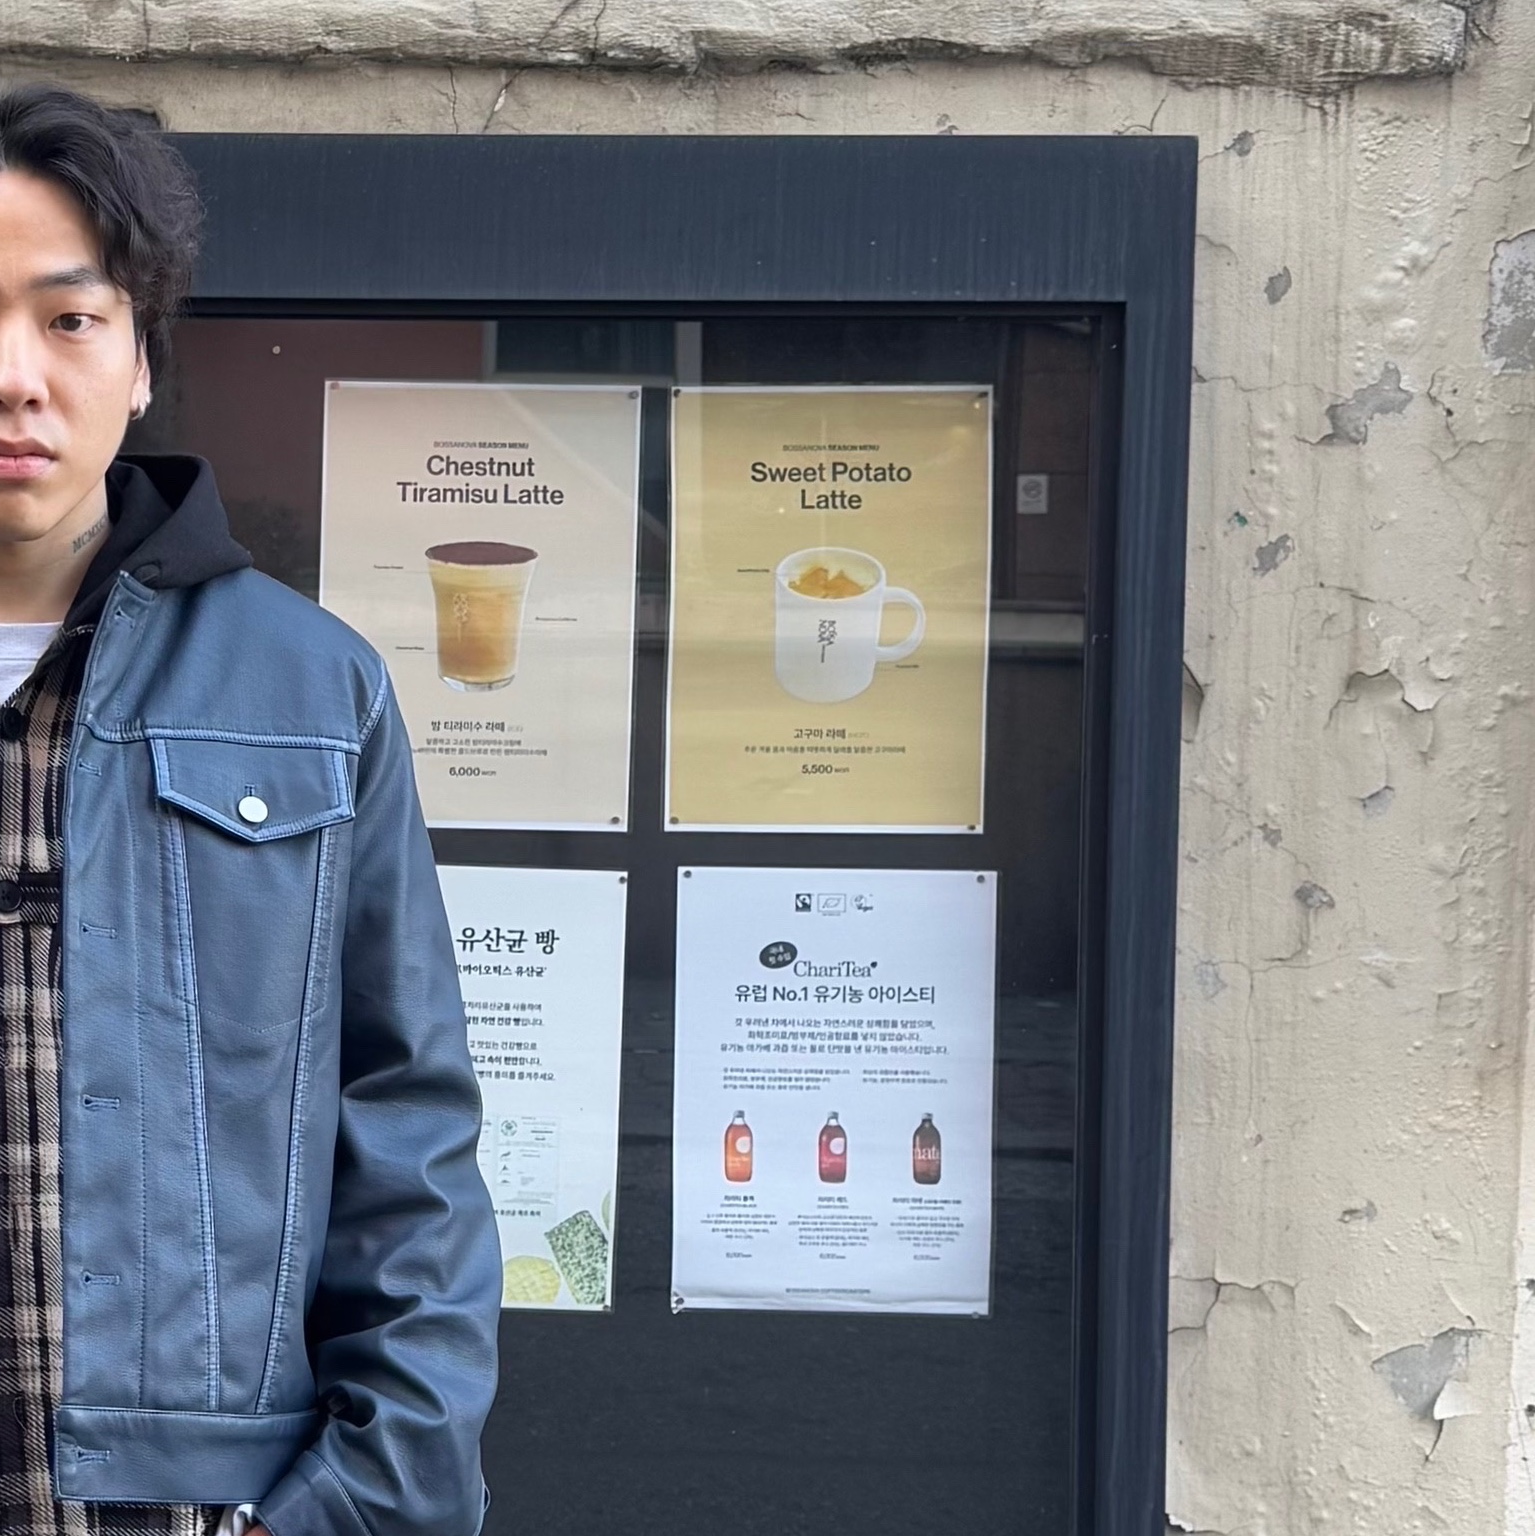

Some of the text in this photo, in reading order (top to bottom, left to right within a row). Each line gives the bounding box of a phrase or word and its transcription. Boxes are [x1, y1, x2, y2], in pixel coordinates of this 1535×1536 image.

[426, 454, 536, 478] Chestnut
[750, 461, 913, 483] Sweet Potato
[397, 482, 565, 505] Tiramisu Latte
[800, 489, 863, 510] Latte
[443, 721, 483, 733] 티라미수
[793, 728, 824, 740] 고구마
[826, 728, 846, 740] 라떼
[449, 767, 481, 778] 6,000
[801, 764, 833, 775] 5,500
[456, 926, 560, 955] 유산균 빵
[793, 960, 872, 978] ChariTea
[734, 984, 936, 1005] 유럽 No.1 유기농 아이스티
